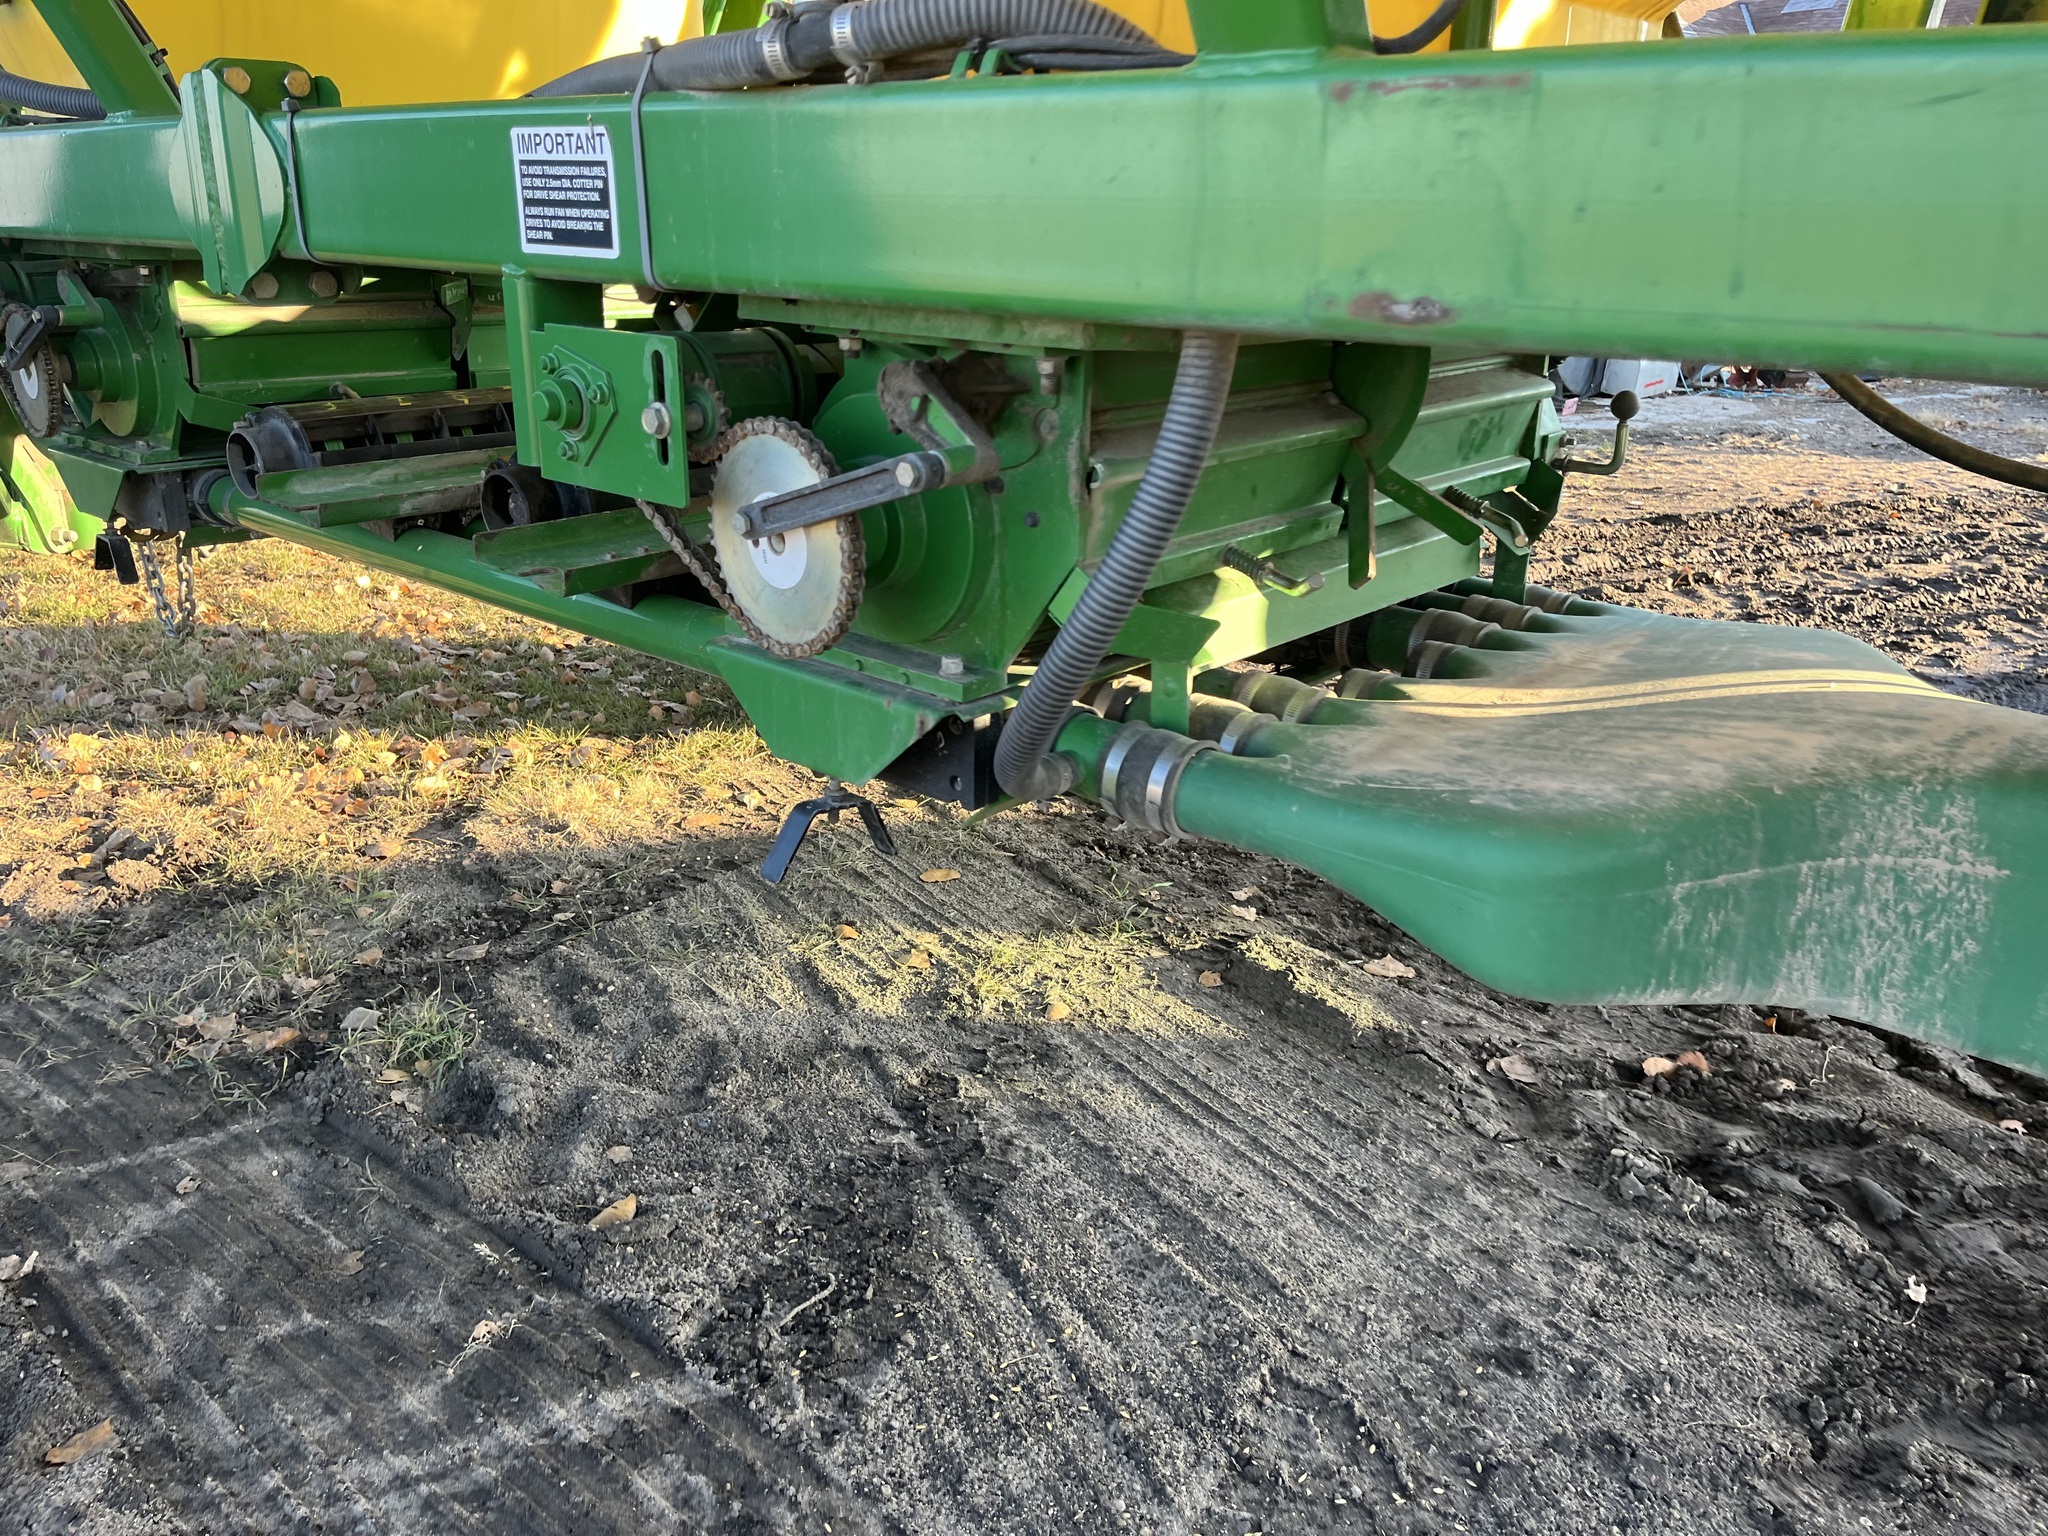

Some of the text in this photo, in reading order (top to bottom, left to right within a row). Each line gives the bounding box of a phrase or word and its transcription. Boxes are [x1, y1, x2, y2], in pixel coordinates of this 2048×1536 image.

[517, 133, 605, 155] IMPORTANT
[520, 166, 606, 178] TO AVOID TRANSMISSION FAILURES,
[522, 178, 532, 186] USE
[532, 178, 545, 187] ONLY
[572, 179, 594, 188] COTTER
[594, 180, 604, 188] PIN
[523, 190, 600, 202] FOR DRIVE SHEAR PROTECTION.
[525, 206, 610, 219] ALWAYS RUN FAN WHEN OPERATING
[526, 218, 604, 232] DRIVES TO AVOID BREAKING THE
[526, 230, 554, 240] SHEAR PIN.
